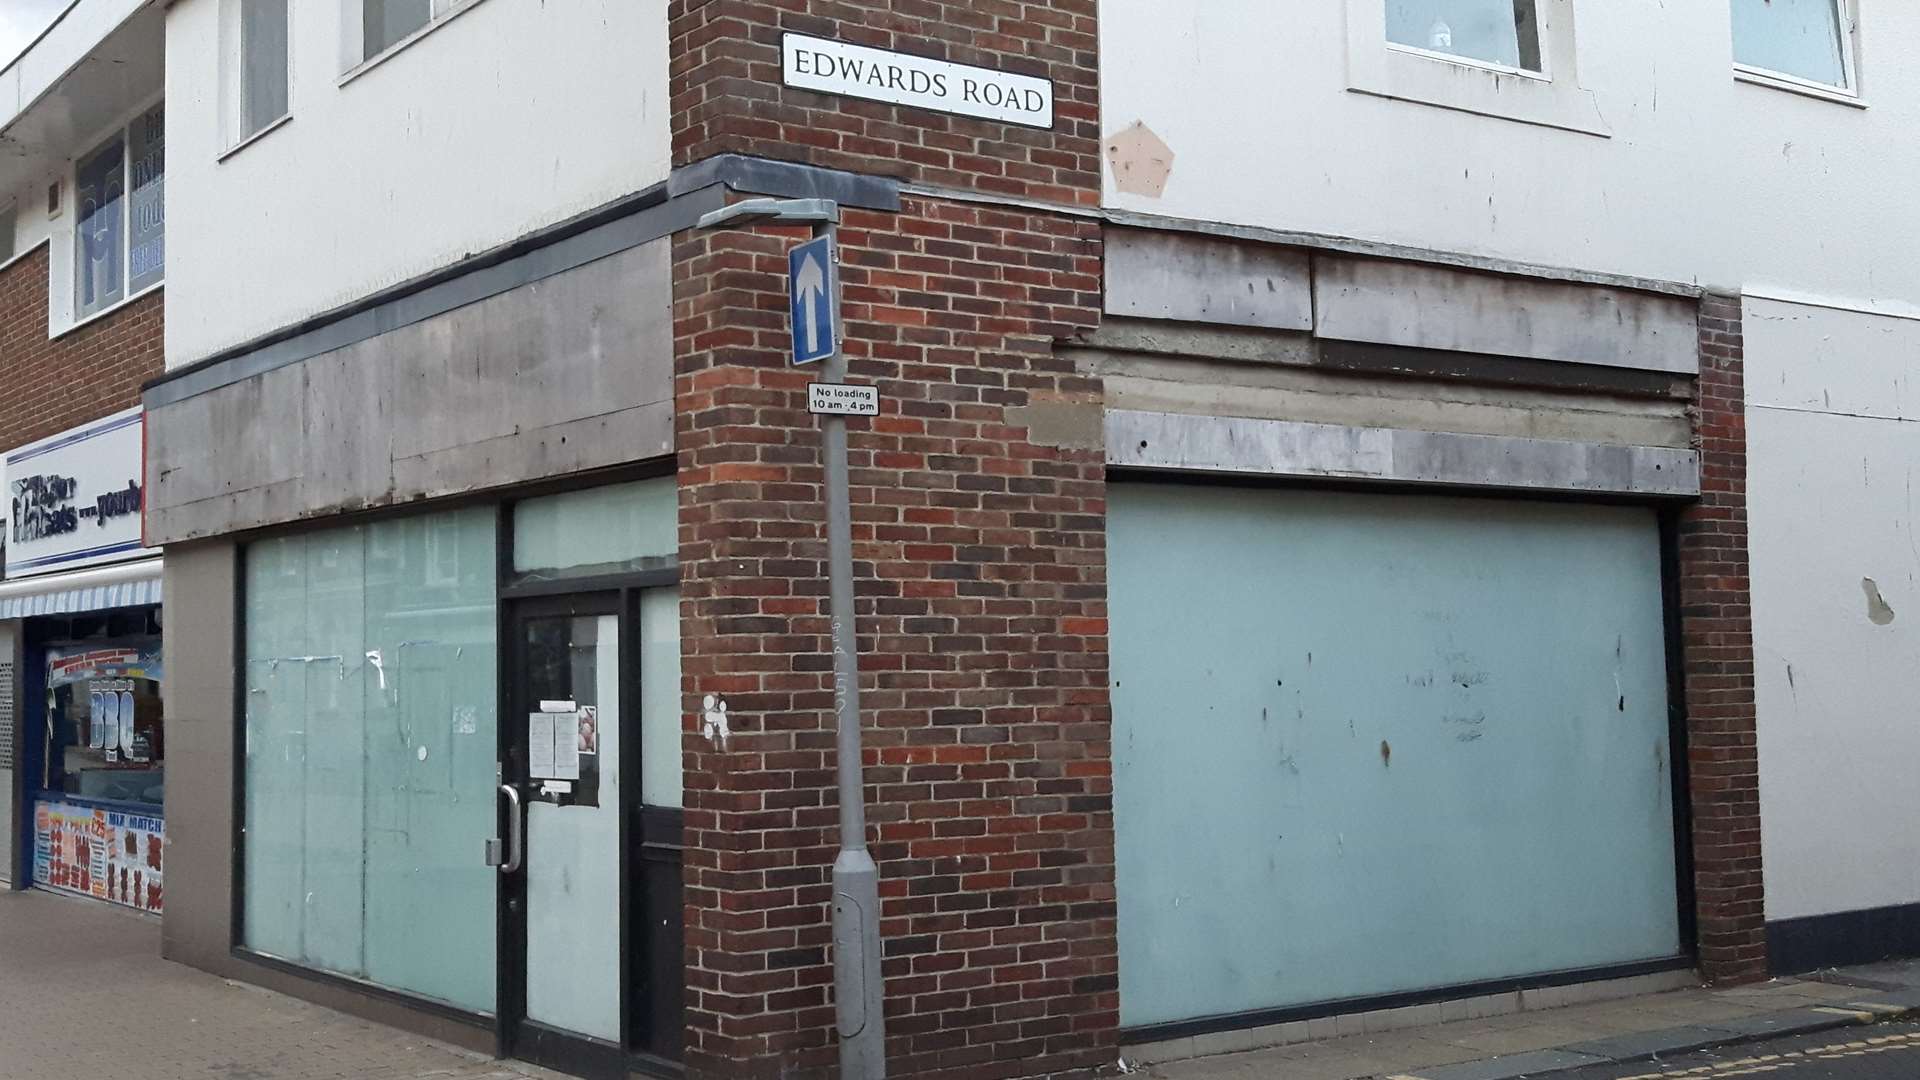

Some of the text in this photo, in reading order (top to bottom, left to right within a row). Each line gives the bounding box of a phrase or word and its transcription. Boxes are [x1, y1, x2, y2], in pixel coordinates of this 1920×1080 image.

[795, 49, 1044, 112] EDWARDS ROAD
[816, 388, 871, 400] No loading
[813, 400, 825, 409] 10
[850, 401, 857, 410] 4
[109, 813, 125, 827] MIX
[129, 815, 162, 833] MATCH
